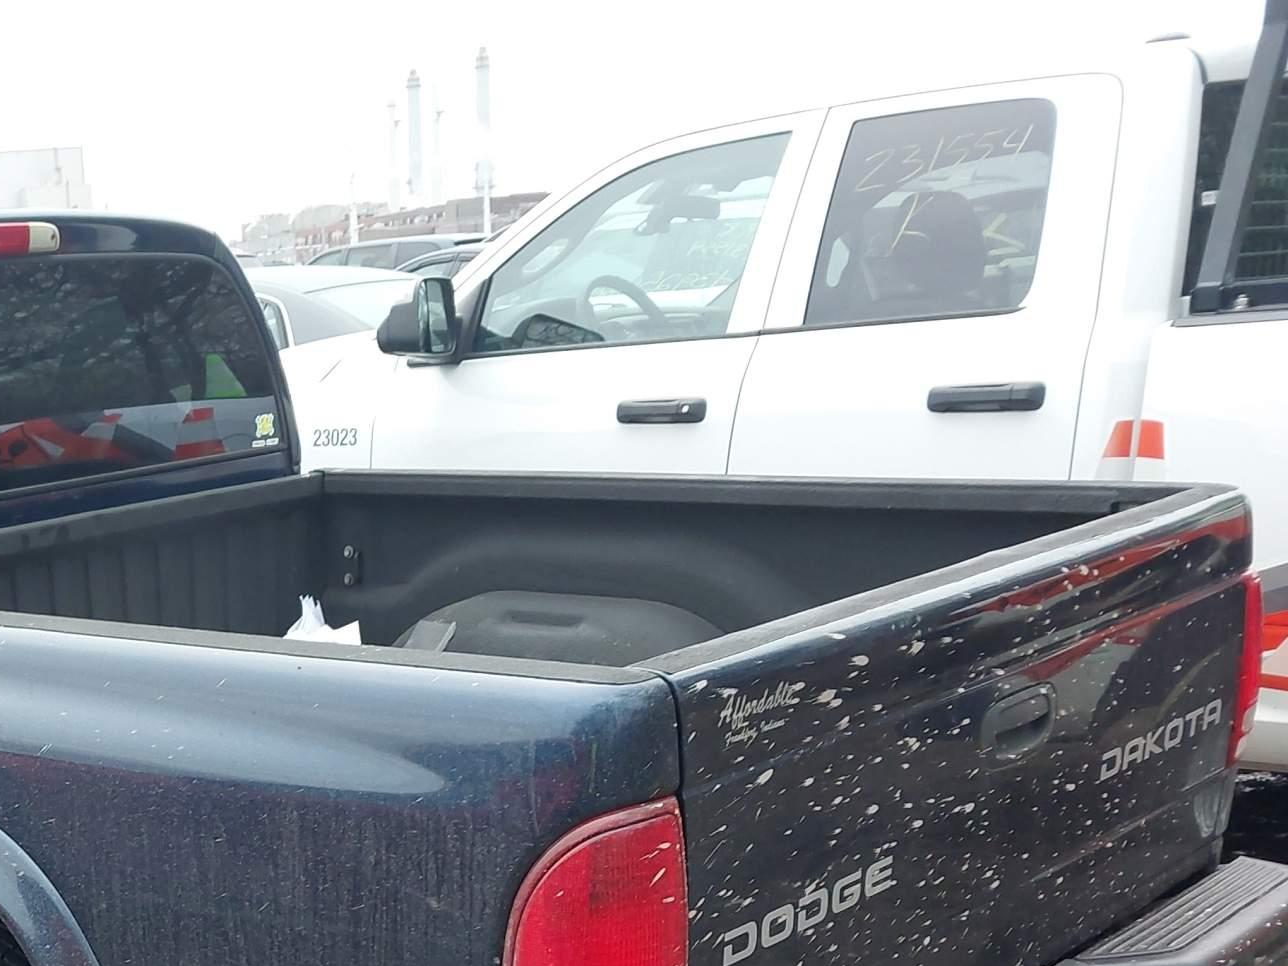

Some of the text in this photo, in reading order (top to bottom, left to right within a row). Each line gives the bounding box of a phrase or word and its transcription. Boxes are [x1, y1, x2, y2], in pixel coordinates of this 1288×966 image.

[855, 123, 1035, 192] 231554
[312, 427, 358, 447] 23023
[718, 680, 802, 730] Affordable
[1100, 698, 1223, 781] DAKOTA
